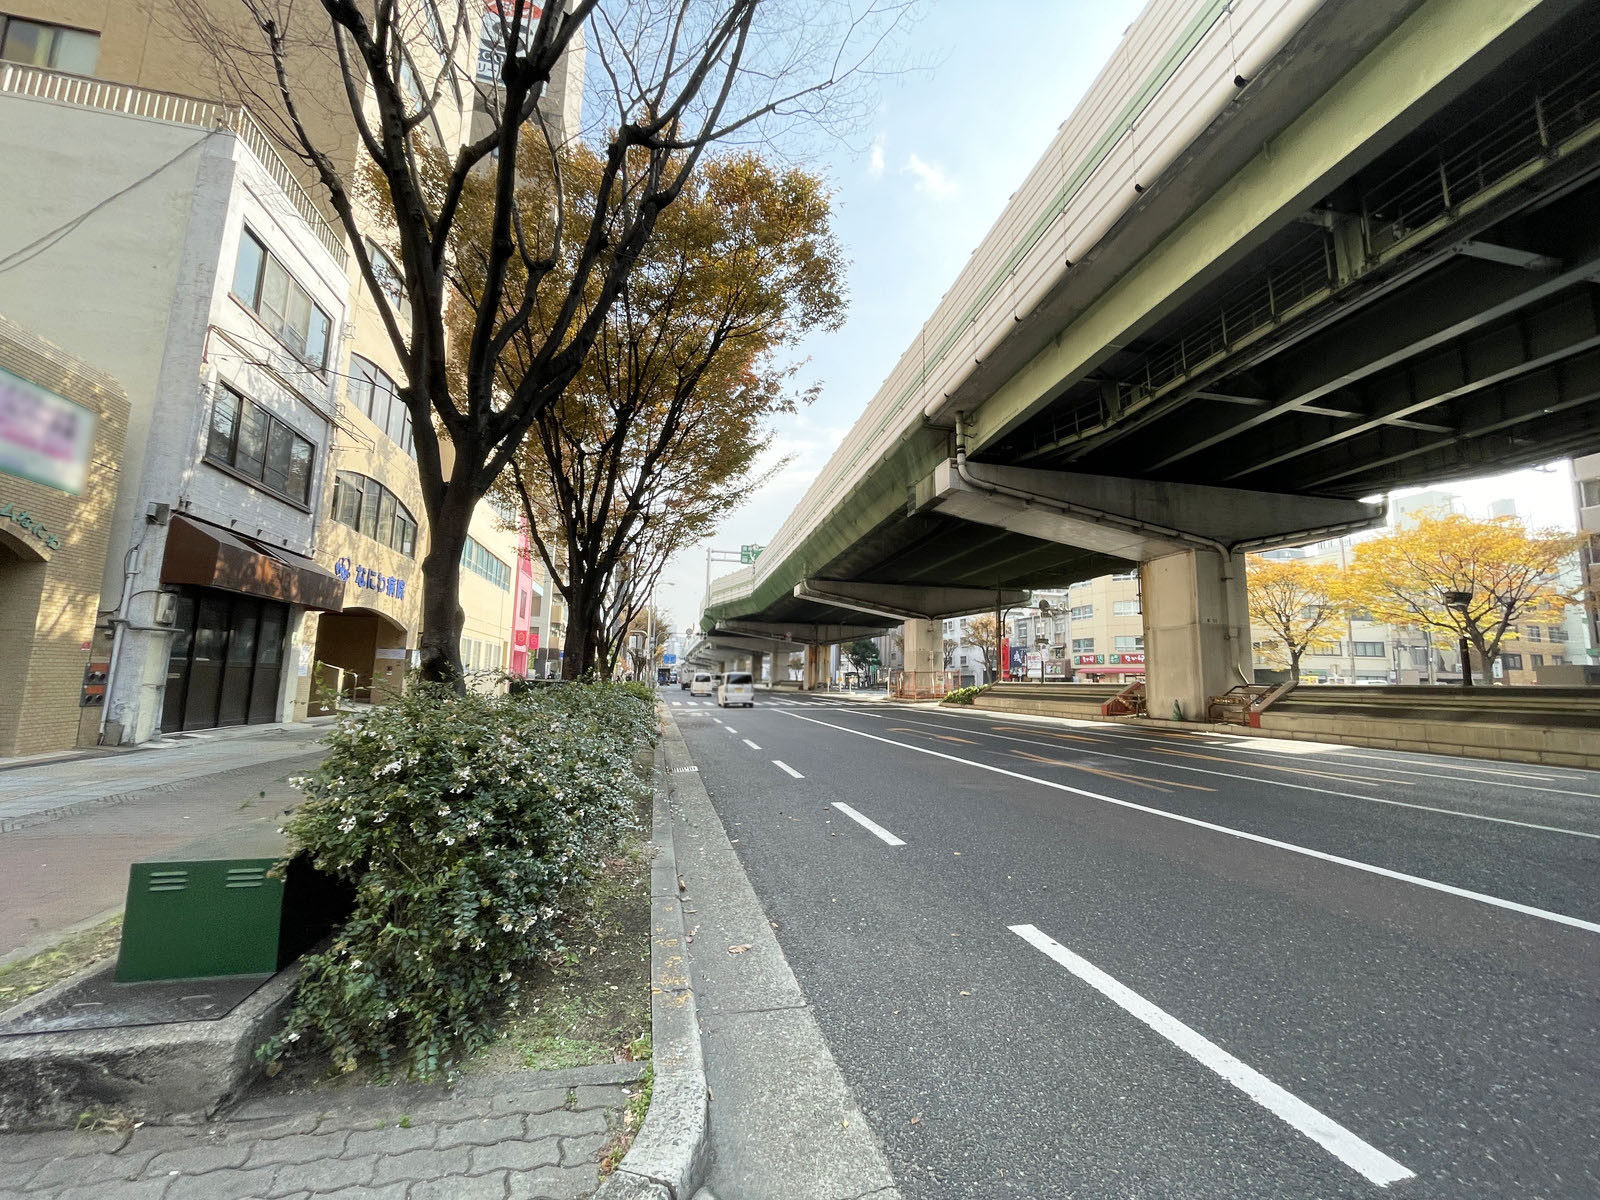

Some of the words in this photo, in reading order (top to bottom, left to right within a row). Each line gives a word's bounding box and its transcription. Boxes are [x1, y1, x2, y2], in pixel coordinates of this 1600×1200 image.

[355, 563, 406, 601] なにわ病院
